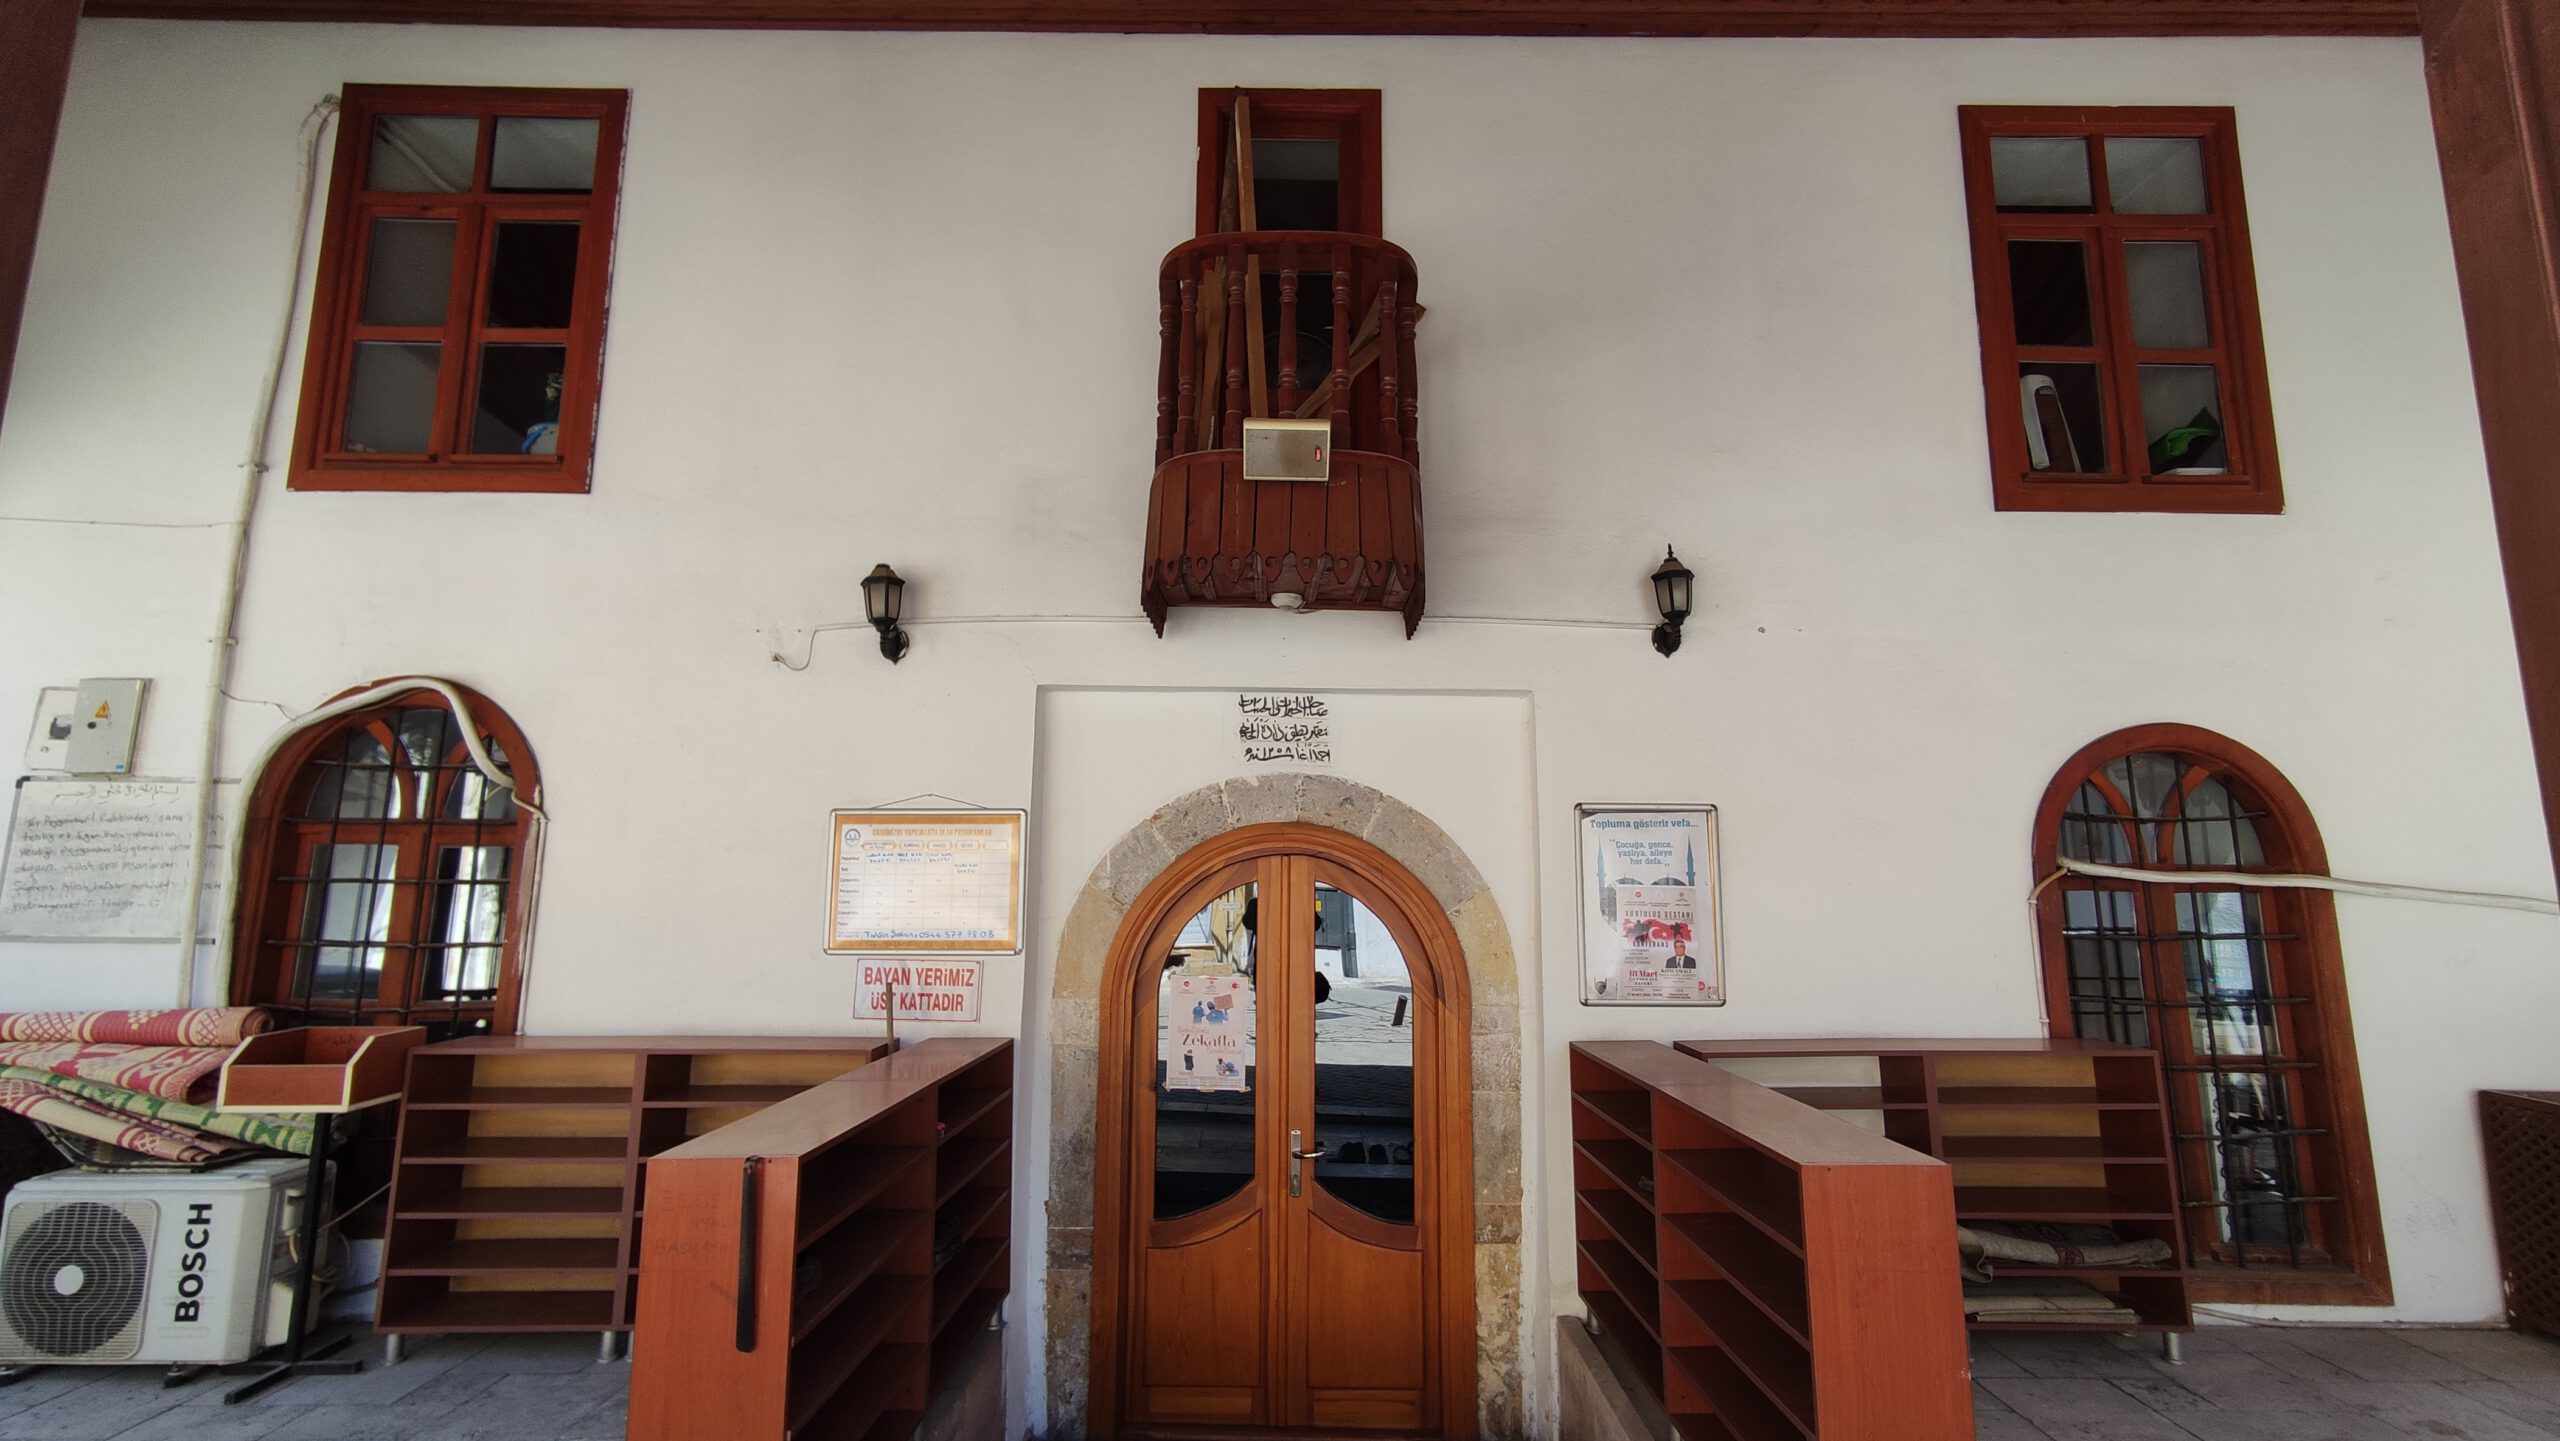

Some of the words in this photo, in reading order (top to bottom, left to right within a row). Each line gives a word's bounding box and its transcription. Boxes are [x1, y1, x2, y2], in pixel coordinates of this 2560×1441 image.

[1590, 819, 1631, 829] Topluma
[1634, 819, 1668, 829] gösterir
[1649, 849, 1673, 858] aileye
[1630, 857, 1643, 865] her
[864, 966, 911, 986] BAYAN
[1639, 969, 1658, 977] Mart
[871, 991, 897, 1011] ÜS
[899, 992, 964, 1012] KATTADIR
[1182, 1033, 1236, 1048] Zekatla
[174, 1203, 213, 1322] BOSCH
